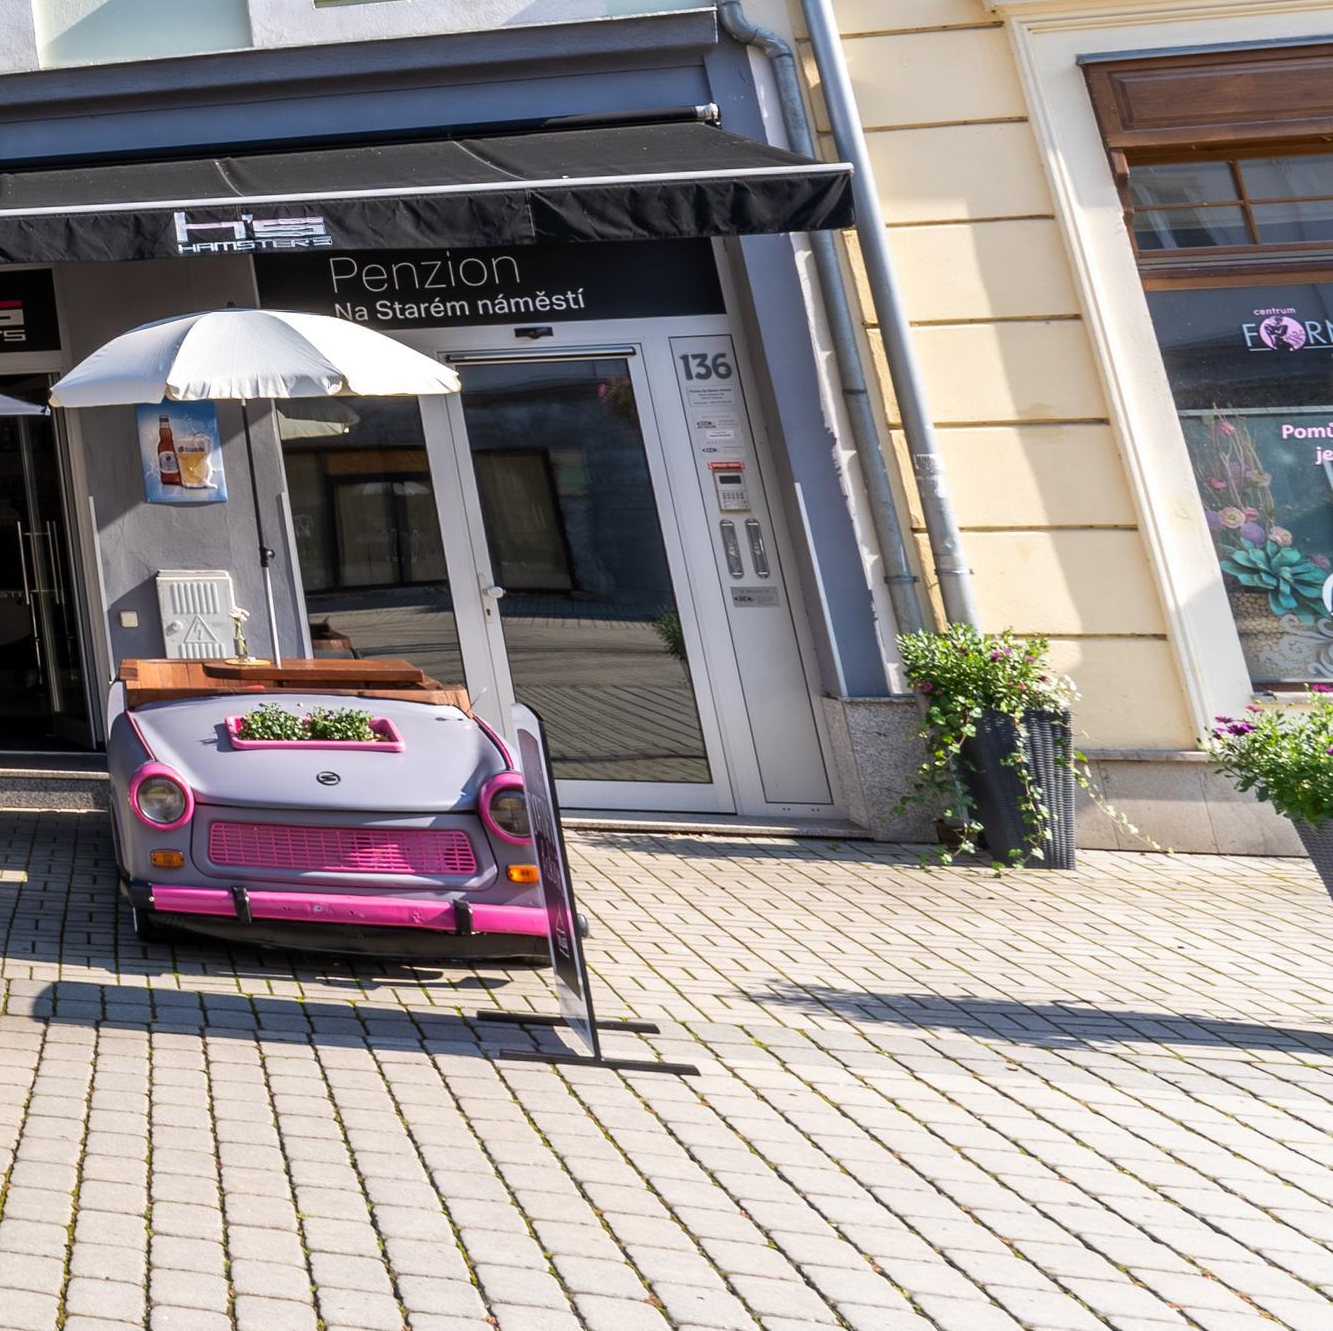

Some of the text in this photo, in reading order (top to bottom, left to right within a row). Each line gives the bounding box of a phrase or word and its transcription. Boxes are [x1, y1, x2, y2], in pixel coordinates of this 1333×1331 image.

[178, 236, 334, 254] HAMSTER'S
[329, 250, 521, 294] Penzion
[334, 288, 586, 321] Na Starém náměstí
[1253, 307, 1296, 316] centrum
[679, 353, 733, 381] 136
